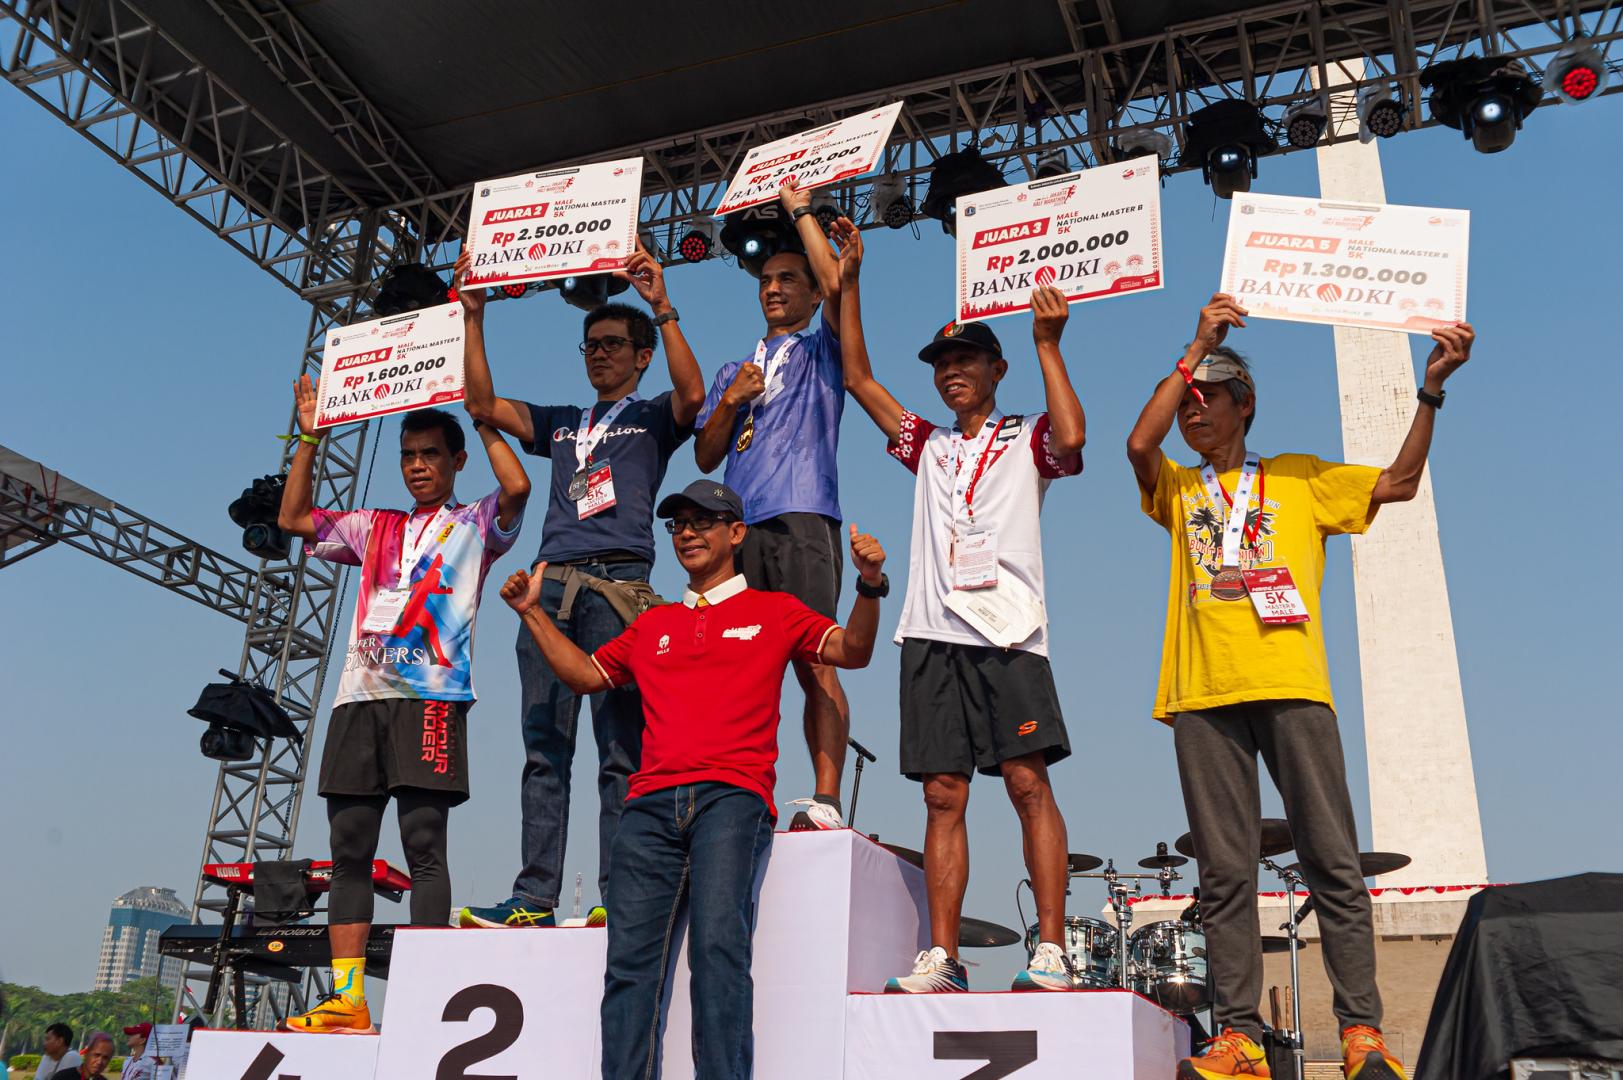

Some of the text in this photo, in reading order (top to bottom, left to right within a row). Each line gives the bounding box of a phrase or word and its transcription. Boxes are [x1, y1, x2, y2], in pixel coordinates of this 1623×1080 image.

[749, 173, 772, 185] Rp
[773, 145, 861, 177] 3.000.000
[730, 179, 779, 201] BANK
[798, 164, 831, 181] DKI
[489, 205, 543, 222] JUARA 2
[553, 202, 590, 212] NATIONAL
[591, 198, 619, 208] MASTER
[553, 210, 565, 218] 5K
[1056, 210, 1080, 221] MALE
[1056, 213, 1099, 227] NATIONAL
[1100, 206, 1136, 219] MASTER
[491, 218, 612, 248] Rp 2.500.000
[979, 221, 1043, 245] JUARA 3
[1057, 225, 1071, 234] 5K
[1254, 232, 1331, 250] JUARA 5
[474, 239, 585, 267] BANK DKI
[986, 230, 1129, 274] Rp 2.000.000
[1347, 245, 1399, 255] NATIONAL
[1399, 249, 1438, 258] MASTER
[1348, 250, 1363, 259] 5K
[970, 257, 1102, 299] BANK DKI
[1263, 258, 1428, 285] Rp 1.300.000
[1239, 278, 1396, 305] BANK DKI
[396, 344, 428, 354] NATIONAL
[429, 339, 453, 347] MASTER
[337, 349, 387, 367] JUARA 4
[343, 356, 446, 390] Rp 1.600.000
[325, 377, 423, 410] BANK DKI
[552, 426, 647, 444] Chpion
[586, 486, 604, 501] 5K
[1265, 591, 1289, 605] 5K
[1271, 608, 1295, 616] MALE
[421, 699, 437, 762] NDER
[433, 700, 449, 774] RMOUR
[216, 866, 241, 878] KORG
[274, 927, 326, 936] Roland
[435, 983, 524, 1080] 2
